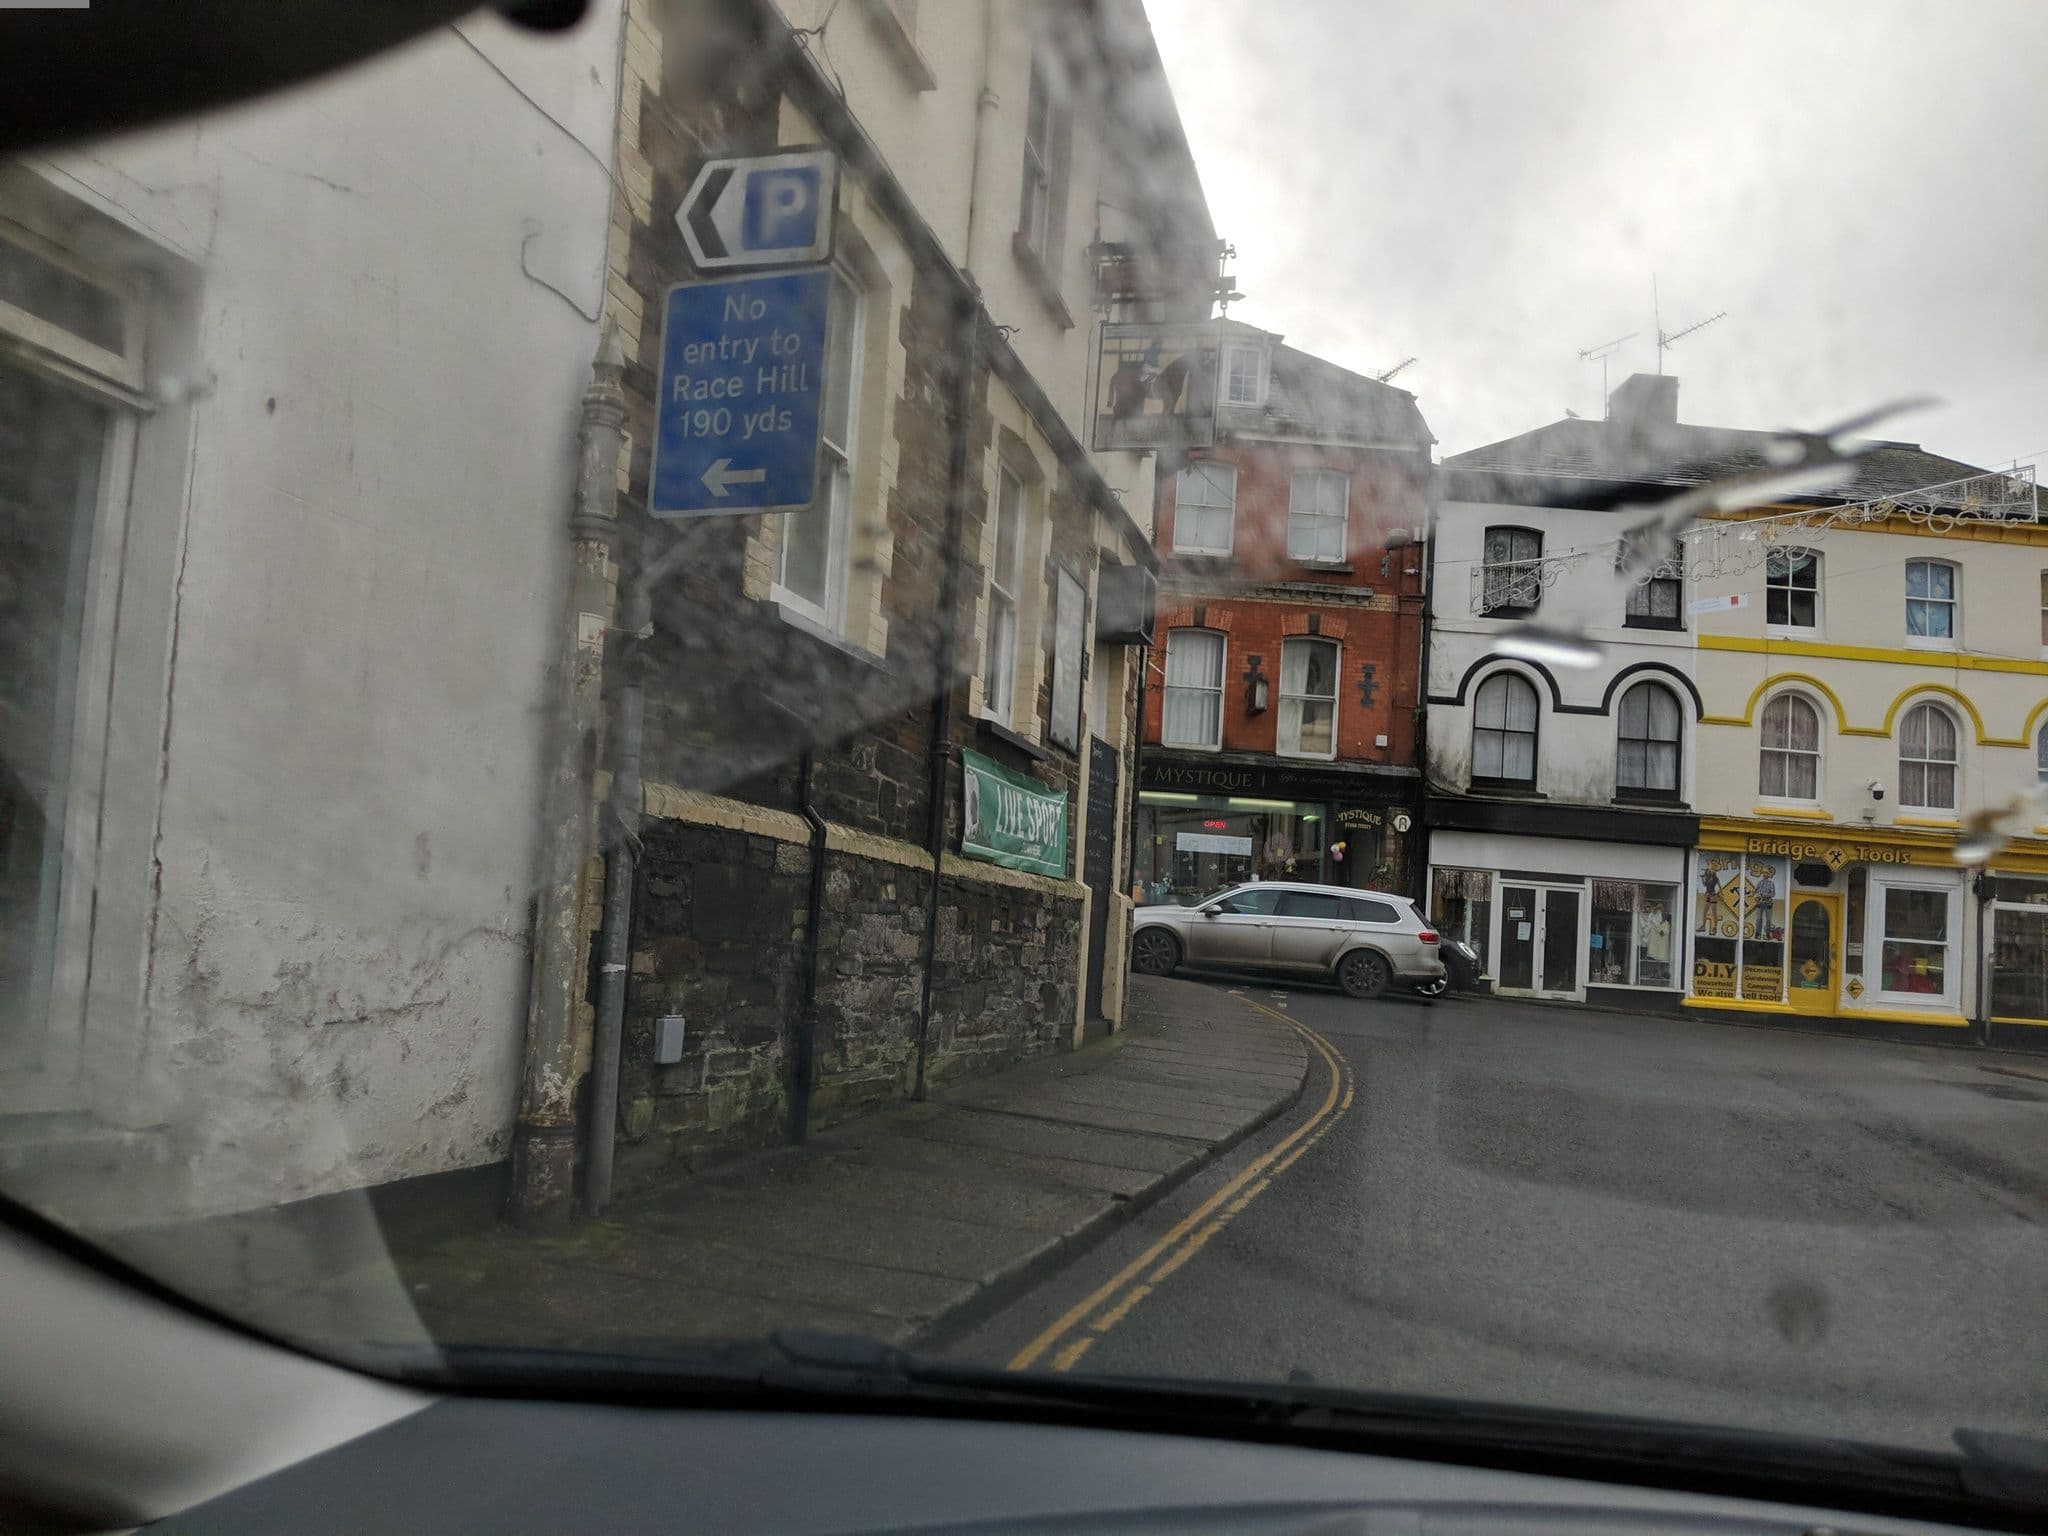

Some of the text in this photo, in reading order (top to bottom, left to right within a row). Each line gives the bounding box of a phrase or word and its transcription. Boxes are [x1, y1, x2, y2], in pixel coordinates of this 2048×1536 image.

[760, 177, 807, 242] P
[723, 293, 767, 322] No
[683, 327, 801, 365] entry to
[673, 363, 809, 402] Race Hill
[681, 404, 793, 440] 190 yds
[1155, 766, 1253, 790] MYSTIQUE
[995, 783, 1025, 840] LIVE
[1026, 796, 1062, 848] SPORT
[1203, 820, 1227, 830] OPEN
[1336, 809, 1382, 826] MYSTIQUE
[1748, 838, 1911, 864] Bridge Tools
